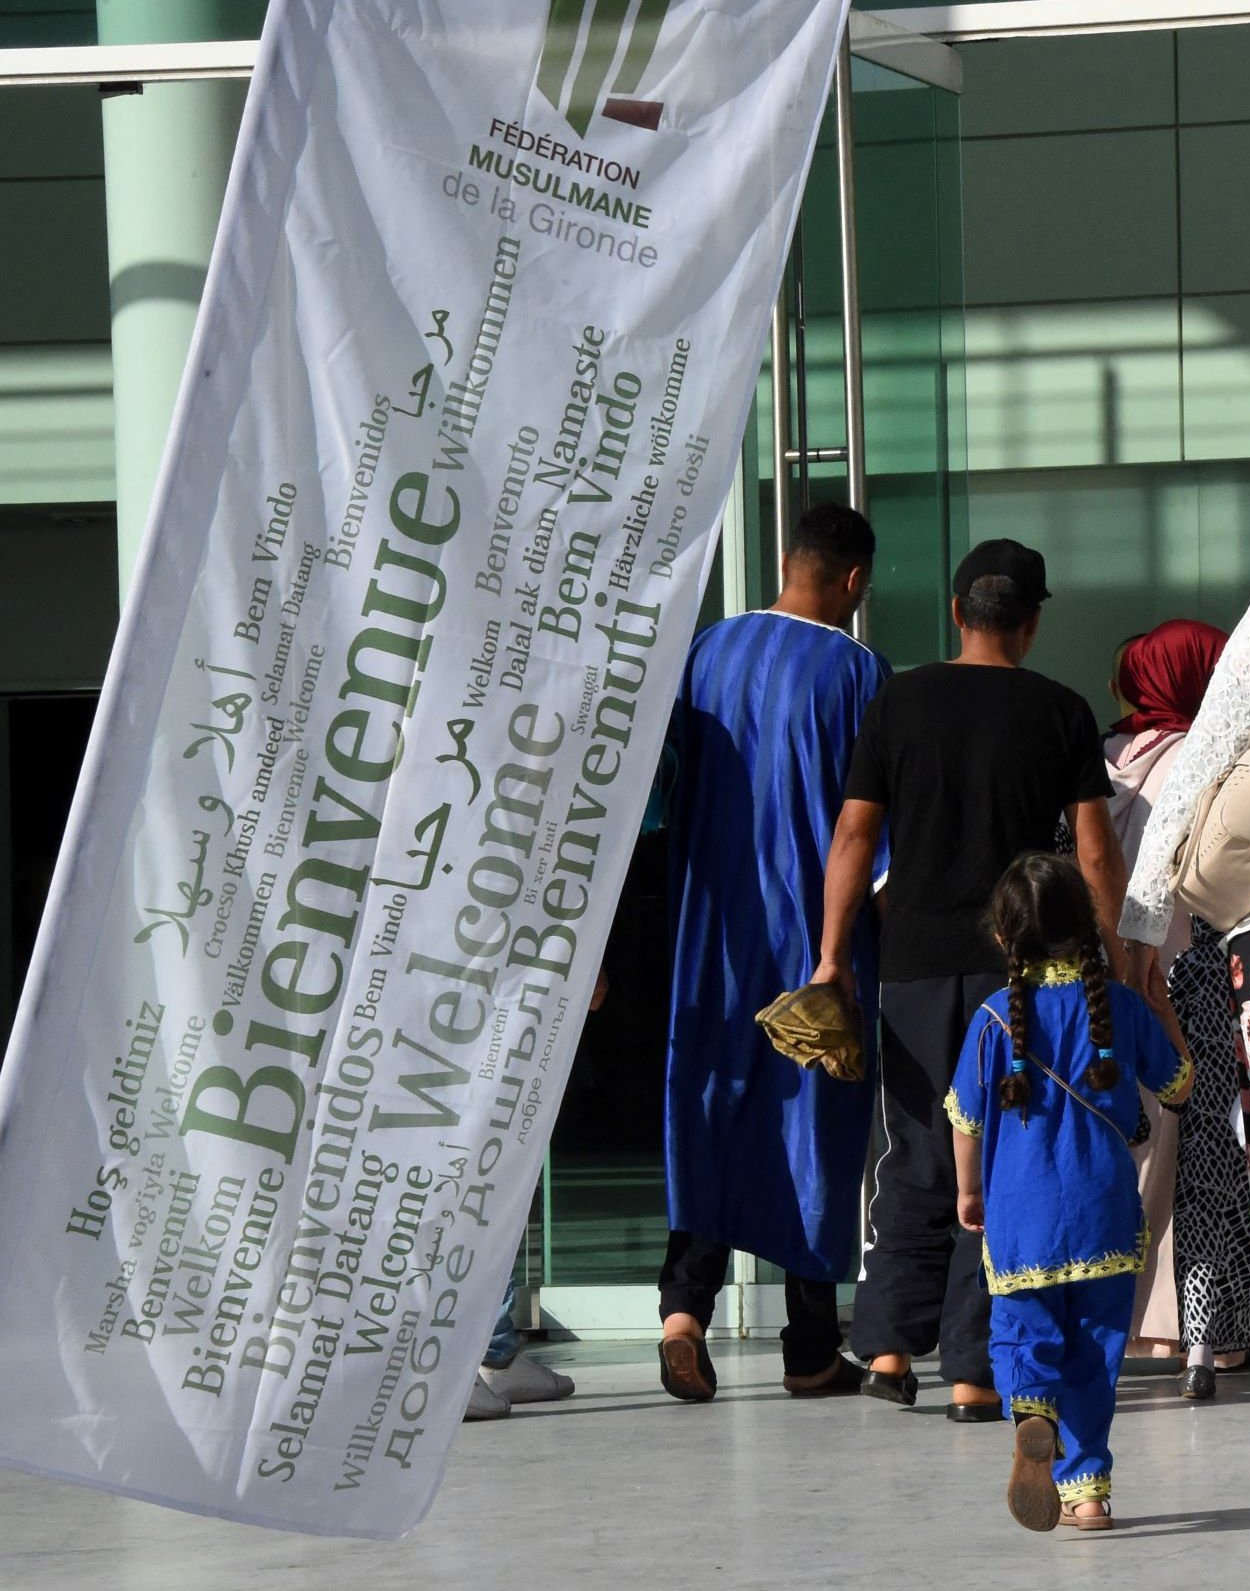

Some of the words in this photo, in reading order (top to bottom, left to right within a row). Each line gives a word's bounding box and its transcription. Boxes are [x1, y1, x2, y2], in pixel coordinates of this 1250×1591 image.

[442, 170, 480, 205] de
[490, 184, 516, 223] la
[528, 201, 658, 267] Gironde
[468, 143, 652, 228] MUSULMANE
[489, 116, 641, 190] FÉDÉRATION
[431, 234, 522, 470] Willkommen
[532, 324, 605, 492] Namaste
[320, 391, 391, 571] Bienvenidos
[566, 370, 643, 504] Vindo
[608, 474, 659, 592] Härzliche
[648, 337, 691, 465] wöikomme
[648, 503, 687, 579] Dobro
[676, 431, 710, 497] došli
[251, 481, 298, 561] Vindo
[474, 425, 540, 597] Benvenuto
[522, 506, 559, 574] diam
[234, 576, 273, 644] Bem
[260, 620, 297, 705] Selamat
[280, 540, 322, 616] Datang
[514, 581, 540, 616] ak
[537, 530, 602, 642] Bem
[281, 644, 325, 742] Welcome
[462, 618, 502, 707] Welkom
[499, 620, 533, 691] Dalal
[569, 664, 599, 735] Swaagat
[178, 470, 461, 1165] Bienvenue
[222, 809, 261, 878] Khush
[252, 714, 286, 802] amdeed
[264, 746, 310, 857] Bienvenue
[506, 591, 661, 981] Benvenuti
[204, 881, 238, 958] Croeso
[367, 702, 566, 1132] Welcome
[369, 892, 408, 956] Vindo
[523, 888, 539, 904] Bi
[538, 820, 558, 852] hati
[221, 871, 277, 1008] Välkommen
[353, 967, 388, 1021] Bem
[64, 1165, 128, 1240] Hoş
[106, 1000, 165, 1156] geldiniz
[143, 1014, 208, 1145] Welcome
[120, 1168, 200, 1344] Benvenuti
[161, 1175, 246, 1336] Welkom
[238, 1024, 383, 1379] Bienvenidos
[343, 1164, 433, 1356] Welcome
[383, 1243, 475, 1469] добре
[458, 983, 551, 1227] дошъл
[83, 1260, 139, 1354] Marsha
[181, 1166, 285, 1398] Bienvenue
[256, 1314, 345, 1483] Selamat
[314, 1149, 400, 1303] Datang
[332, 1309, 421, 1492] Willkommen
